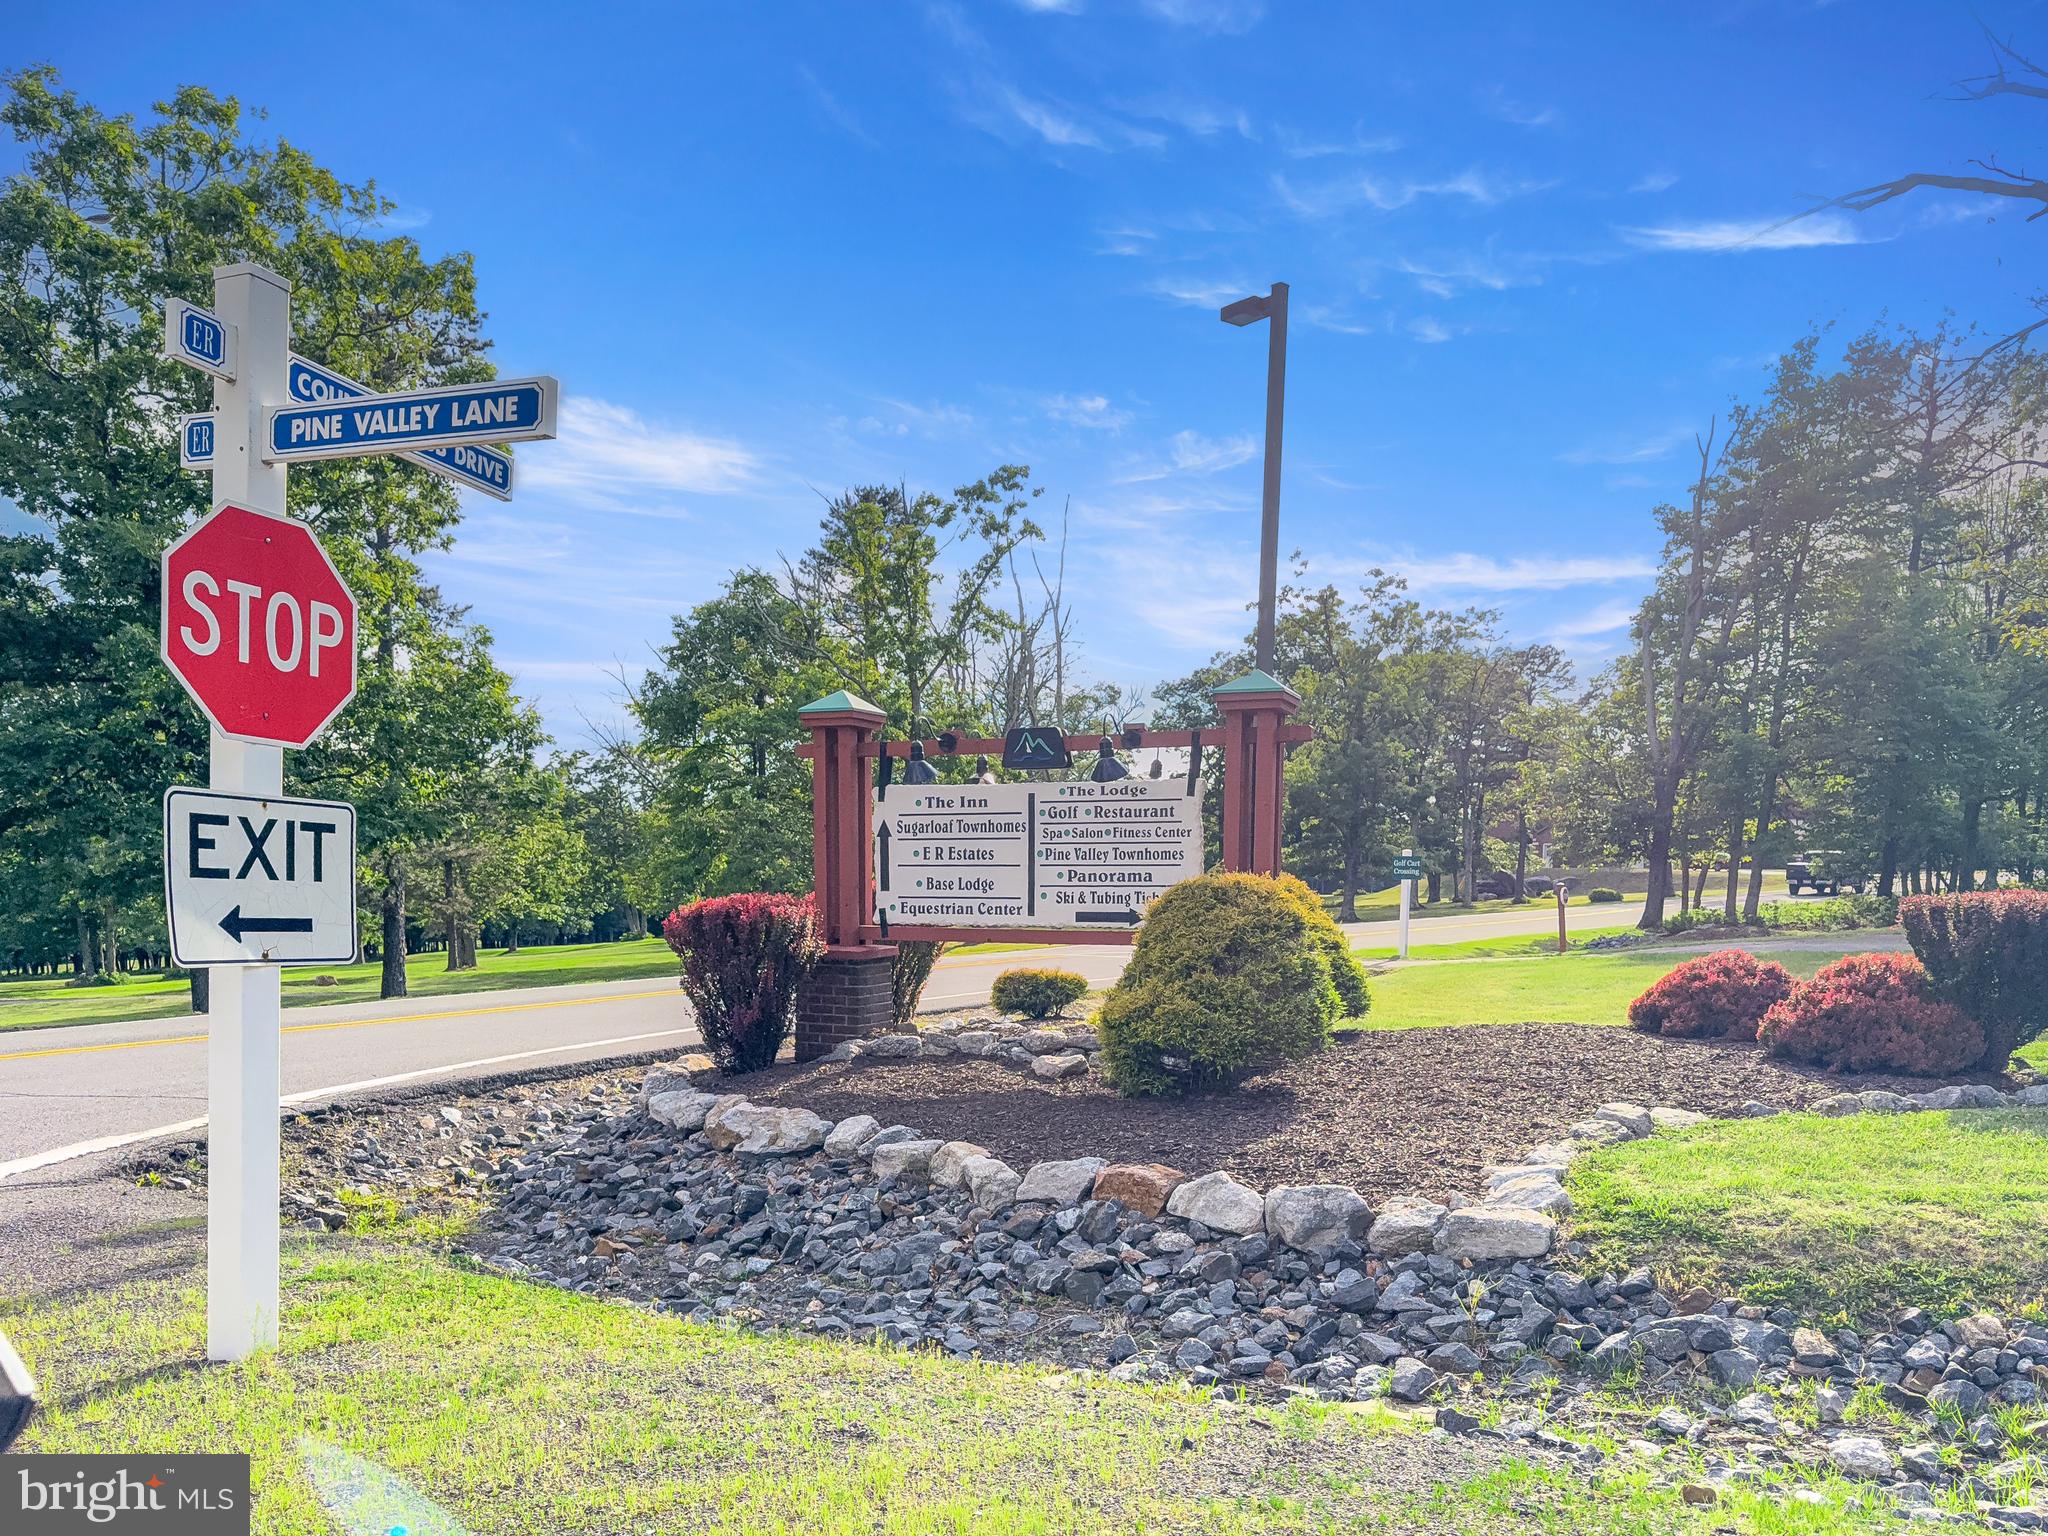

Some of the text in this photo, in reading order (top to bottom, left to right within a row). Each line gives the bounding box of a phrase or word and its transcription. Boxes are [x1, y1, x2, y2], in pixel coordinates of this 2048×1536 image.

[192, 319, 214, 356] ER
[291, 396, 519, 443] PINE VALLEY LANE
[192, 425, 210, 453] ER
[454, 447, 504, 484] DRIVE
[180, 569, 344, 678] STOP
[1066, 785, 1148, 798] The Lodge
[925, 796, 988, 809] The Inn
[1047, 805, 1175, 819] Golf Restaurant
[896, 819, 1027, 836] Sugarloaf Townhomes
[1042, 826, 1192, 841] Spa Salon Fitness Center
[189, 812, 336, 883] EXIT
[923, 846, 995, 861] E R Estates
[1045, 847, 1184, 863] Pine Valley Townhomes
[1393, 859, 1420, 867] Golf Cart
[1067, 869, 1153, 883] Panorama
[1393, 868, 1420, 877] Crossing
[926, 877, 995, 894] Base Lodge
[1055, 891, 1074, 904] Ski
[1078, 891, 1087, 904] &
[1089, 890, 1131, 907] Tubing
[900, 901, 1023, 917] Equestrian Center
